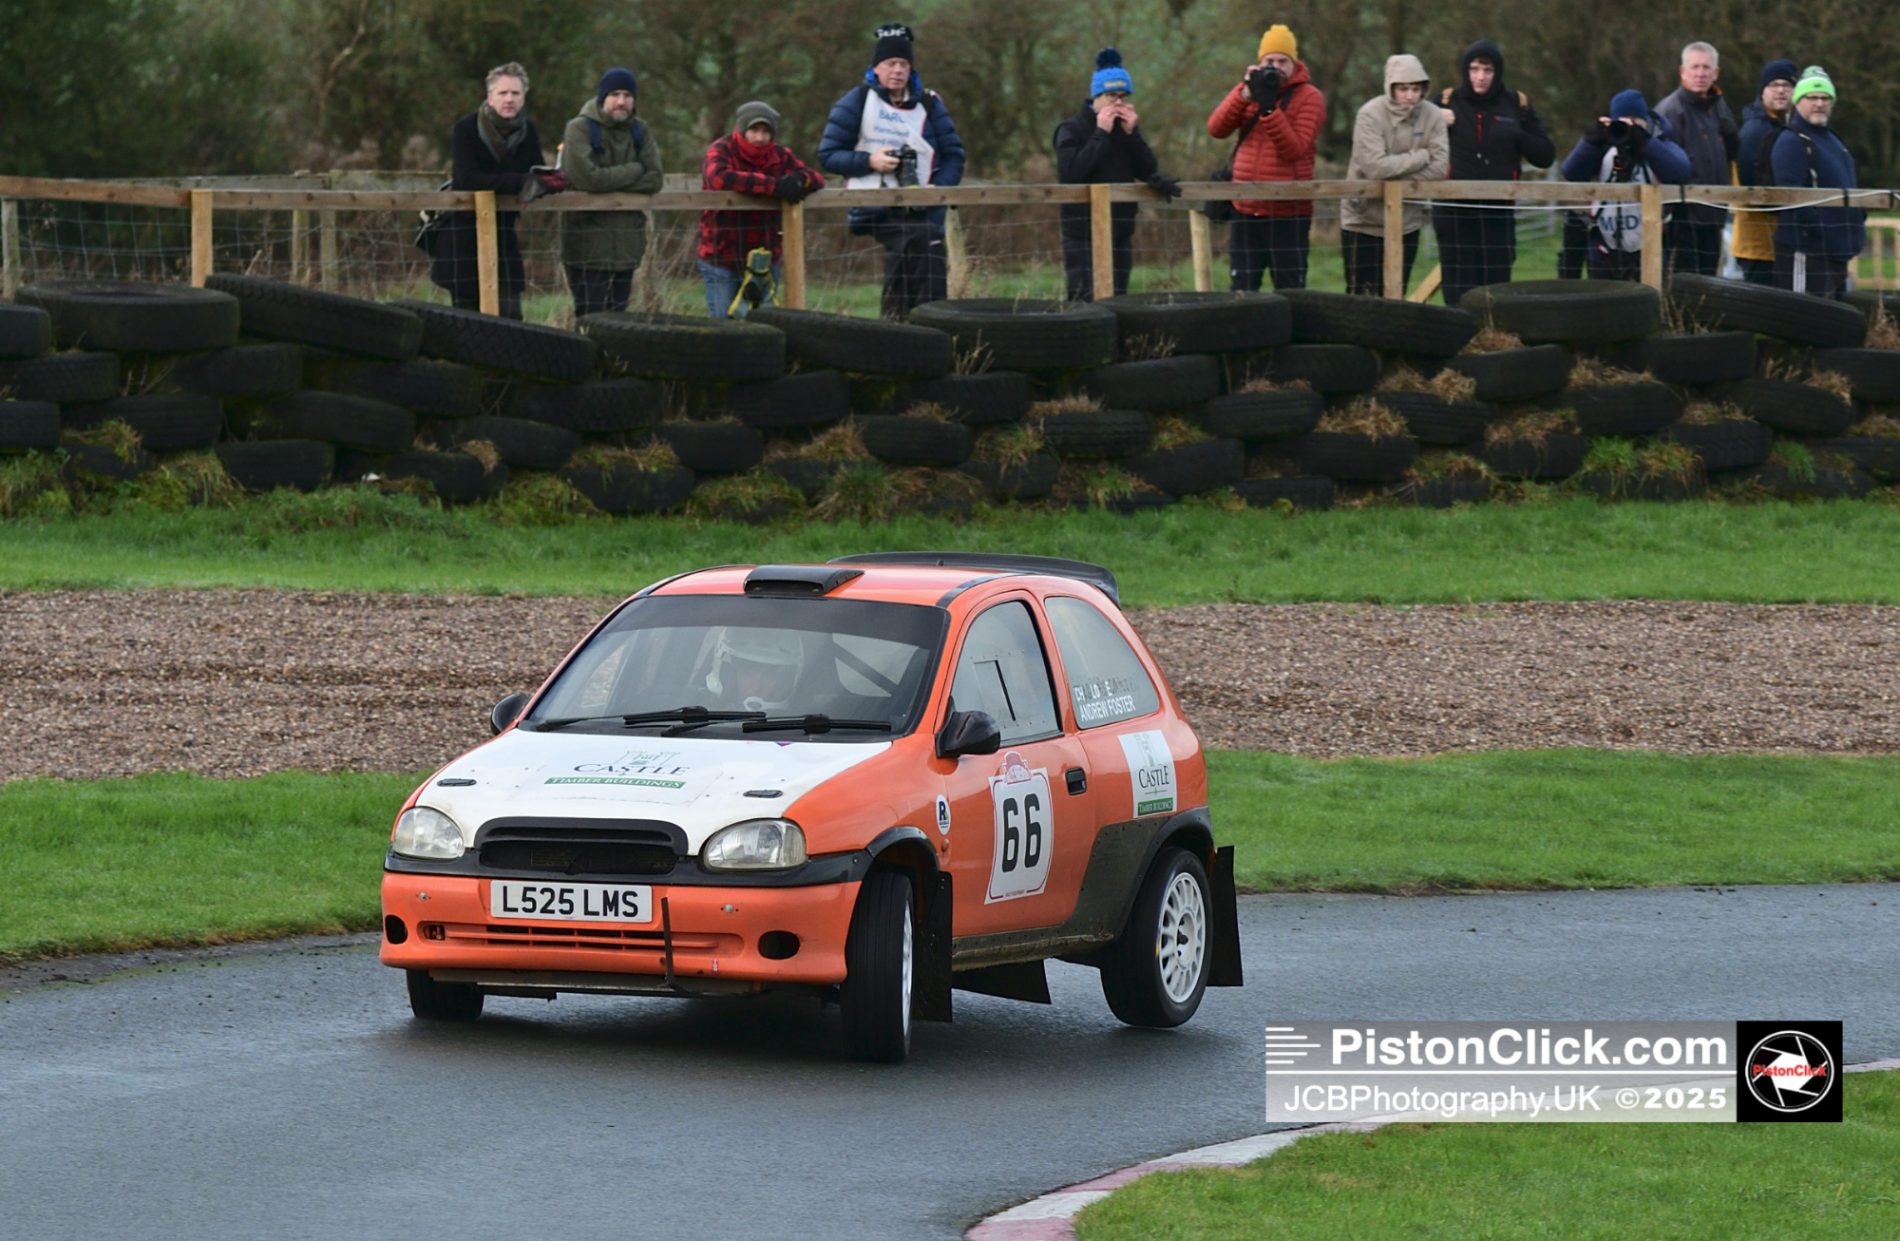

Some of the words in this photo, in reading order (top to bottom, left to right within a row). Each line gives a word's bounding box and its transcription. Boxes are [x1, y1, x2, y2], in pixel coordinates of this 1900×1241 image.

[1079, 699, 1110, 722] ANDREW
[1107, 695, 1136, 715] FOSTER
[573, 763, 690, 775] CASTLE
[1138, 766, 1169, 788] CASTLE
[604, 778, 681, 787] BUILDINGS
[938, 800, 947, 821] R
[1002, 793, 1042, 873] 66
[502, 885, 575, 916] L525
[583, 889, 639, 918] LMS
